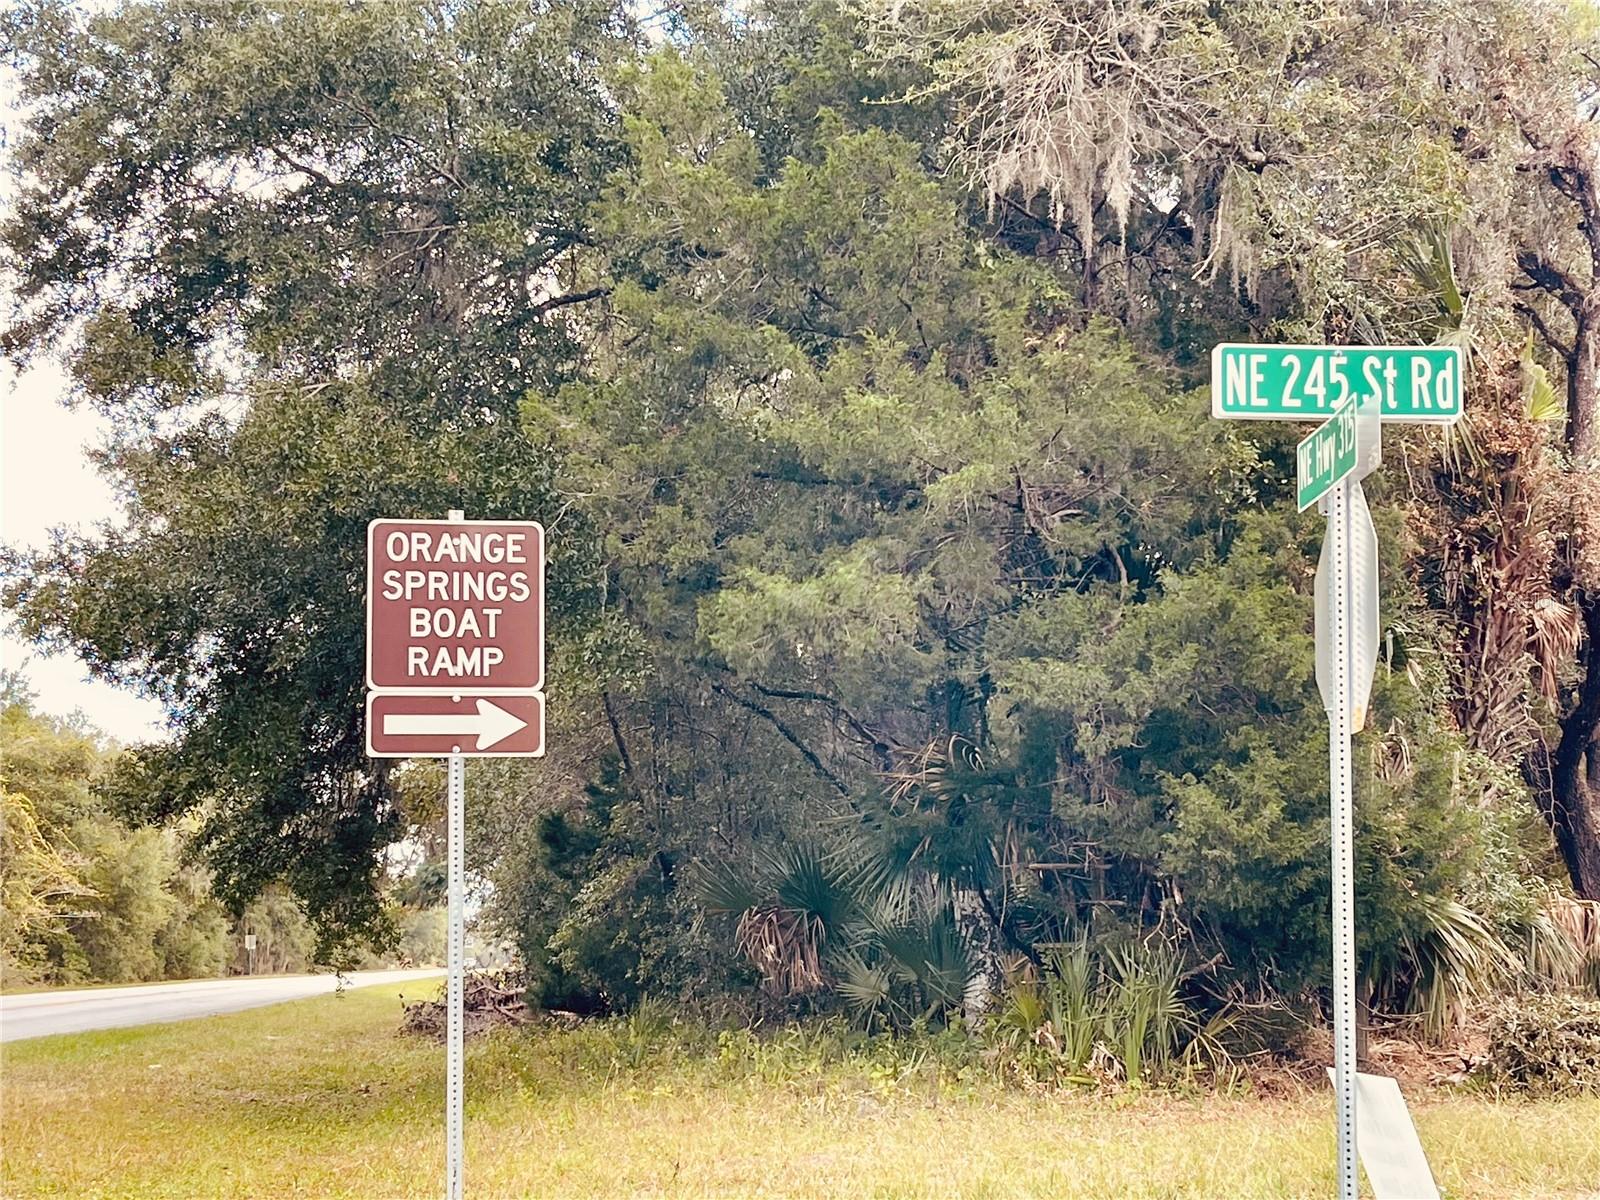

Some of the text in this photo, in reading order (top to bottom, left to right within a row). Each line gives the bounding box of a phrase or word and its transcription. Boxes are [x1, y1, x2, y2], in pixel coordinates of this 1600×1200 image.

[1226, 354, 1454, 409] NE 245 St Rd
[1298, 405, 1355, 491] NE Hwy 315
[386, 531, 527, 564] ORANGE
[382, 570, 531, 602] SPRINGS
[410, 608, 502, 638] BOAT
[407, 646, 504, 676] RAMP
